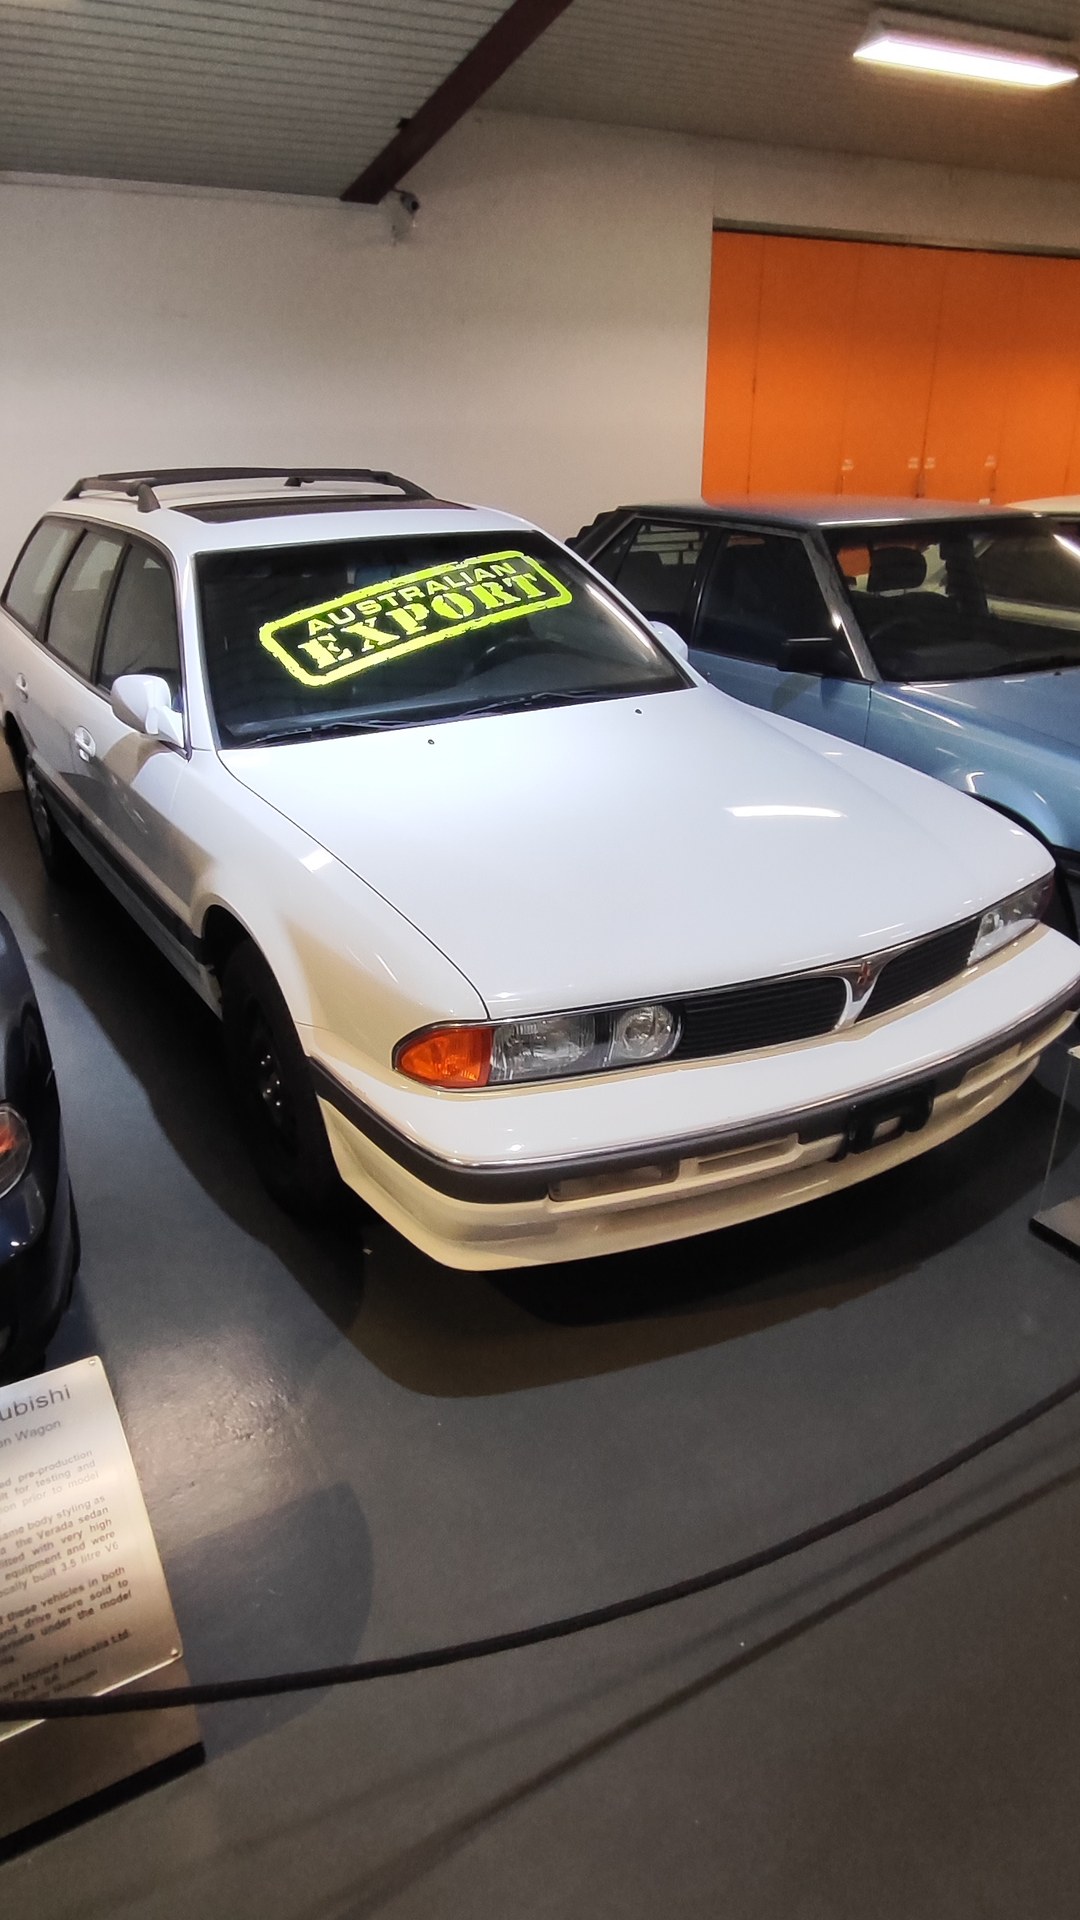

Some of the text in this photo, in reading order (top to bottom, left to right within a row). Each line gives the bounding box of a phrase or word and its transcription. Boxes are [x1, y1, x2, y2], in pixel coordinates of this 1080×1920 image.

[307, 562, 517, 636] AUSTRALIAN
[298, 573, 547, 669] EXPORT
[15, 1420, 61, 1441] Wagon
[14, 1485, 29, 1495] for
[36, 1470, 71, 1488] testing
[77, 1459, 95, 1473] and
[18, 1450, 93, 1482] pre-production
[22, 1491, 46, 1507] prior
[52, 1485, 62, 1495] to
[68, 1470, 99, 1488] model
[15, 1536, 33, 1549] the
[36, 1520, 73, 1540] Verada
[78, 1506, 109, 1523] sedan
[27, 1516, 53, 1530] body
[57, 1500, 91, 1519] styling
[94, 1495, 106, 1505] as
[5, 1531, 115, 1580] equipment and were
[32, 1541, 54, 1556] with
[61, 1530, 83, 1544] very
[90, 1518, 112, 1533] high
[32, 1567, 56, 1583] built
[81, 1550, 101, 1564] litre
[105, 1540, 119, 1553] V6
[41, 1585, 85, 1607] vehicles
[88, 1578, 98, 1589] in
[102, 1566, 125, 1582] both
[58, 1599, 83, 1614] were
[90, 1584, 112, 1601] sold
[118, 1579, 129, 1589] to
[40, 1589, 132, 1636] under the model
